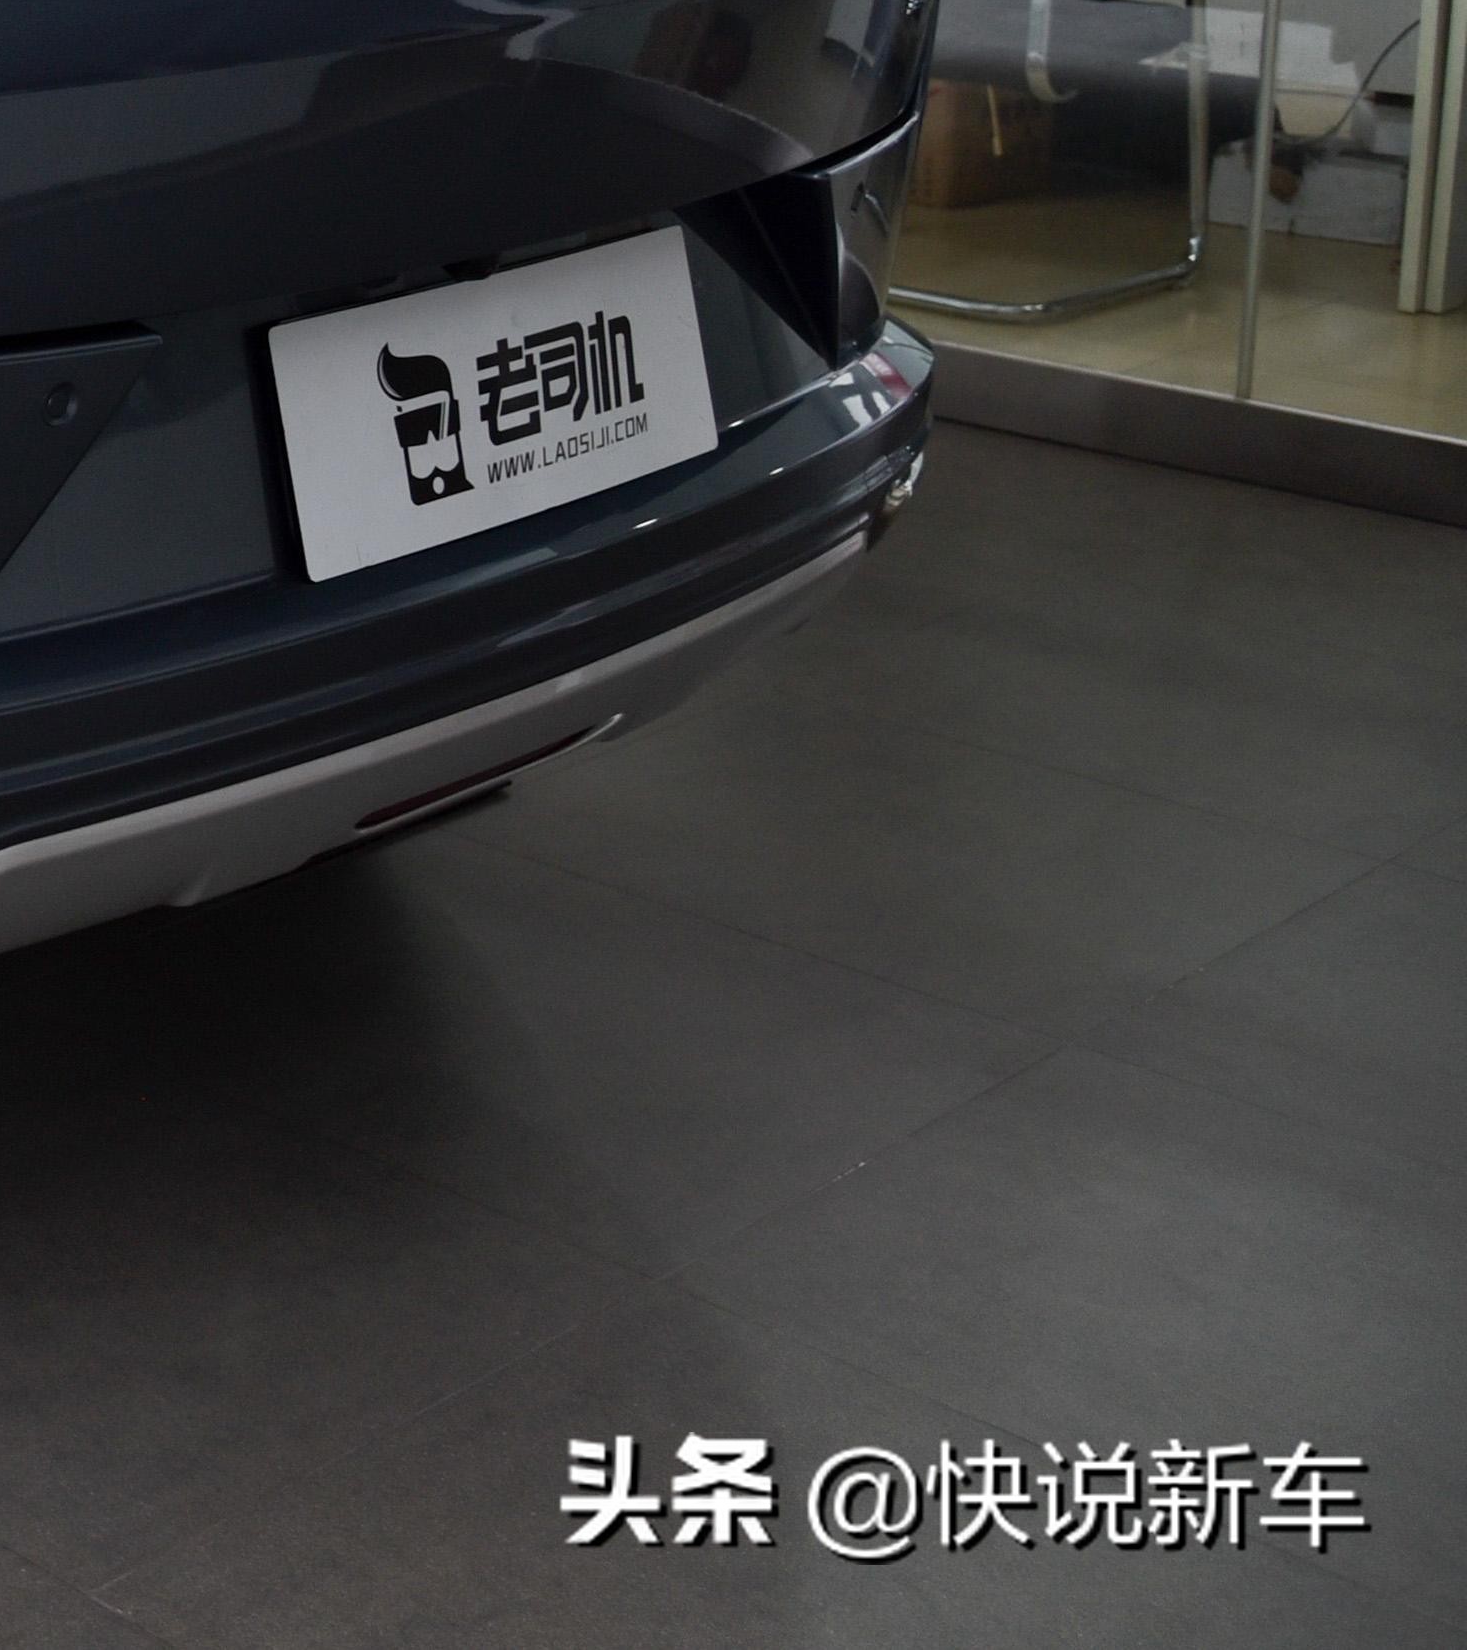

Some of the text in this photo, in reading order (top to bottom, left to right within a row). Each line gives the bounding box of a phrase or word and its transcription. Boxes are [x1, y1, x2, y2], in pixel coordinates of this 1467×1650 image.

[476, 311, 645, 446] 老司机
[487, 412, 649, 484] WWW.LAOSIJI.COM
